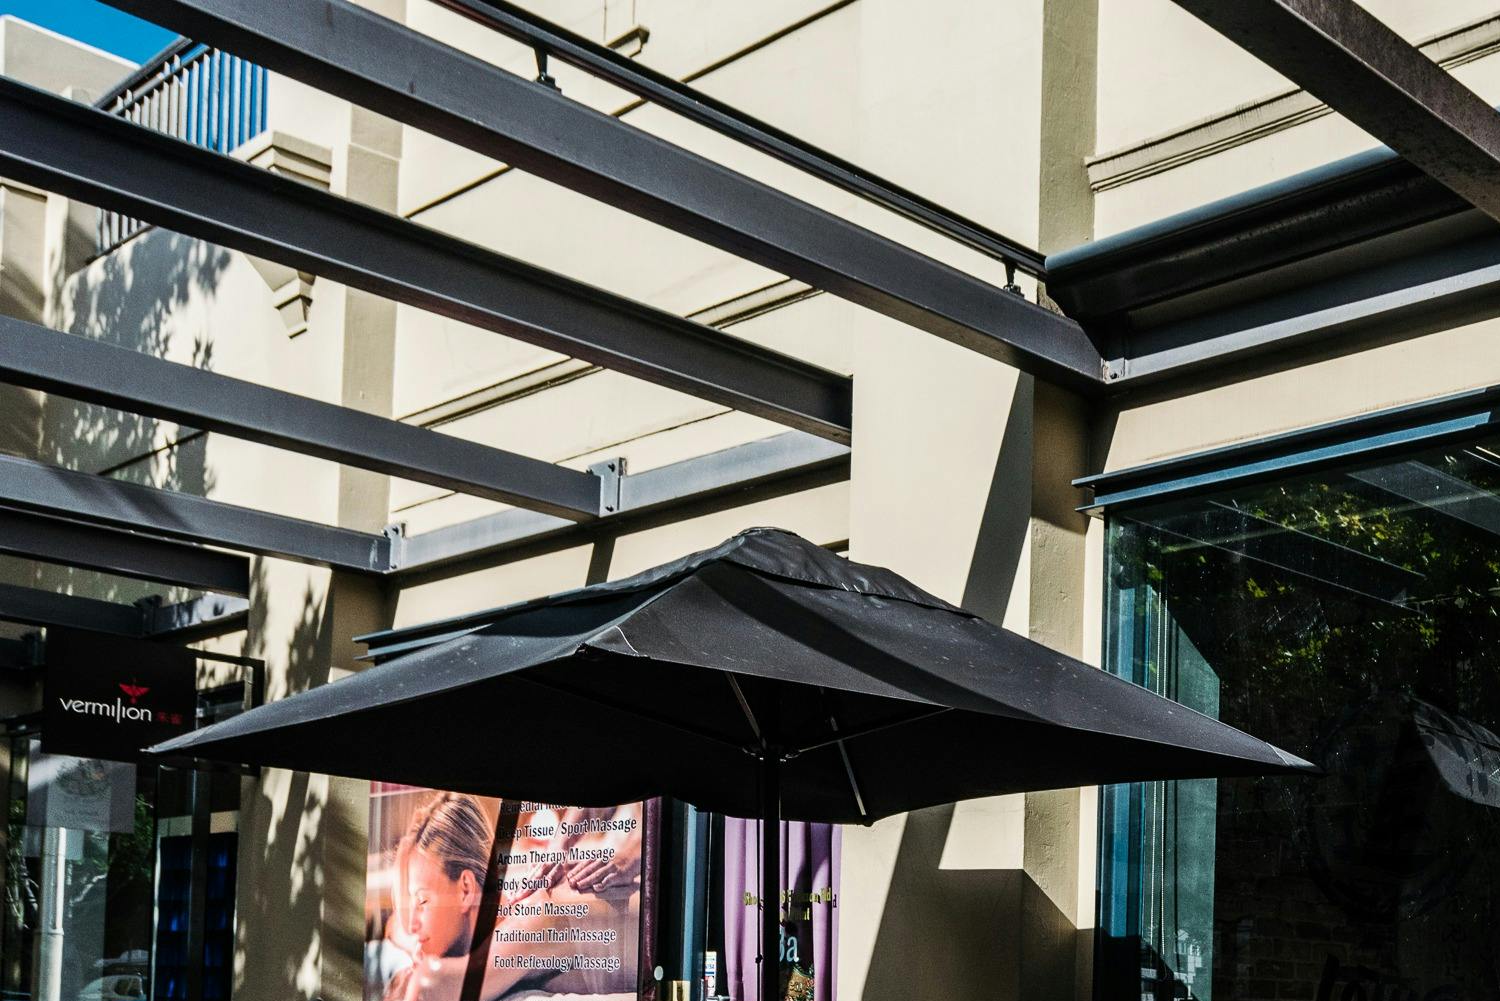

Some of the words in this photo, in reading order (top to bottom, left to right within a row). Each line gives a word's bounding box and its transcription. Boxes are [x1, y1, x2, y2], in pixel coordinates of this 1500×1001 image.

[59, 697, 151, 723] vermilion
[590, 818, 637, 833] Massage
[498, 853, 526, 865] Aroma
[530, 850, 567, 865] Therapy
[569, 848, 615, 864] Massage
[498, 878, 519, 893] Body
[522, 877, 549, 890] Scrub
[497, 904, 512, 916] Hot
[514, 903, 541, 916] Stone
[544, 902, 589, 918] Massage
[495, 930, 545, 943] Traditional
[547, 929, 568, 942] Thai
[570, 928, 616, 944] Massage
[494, 956, 514, 968] Foot
[517, 955, 573, 972] Reflexology
[574, 955, 620, 972] Massage
